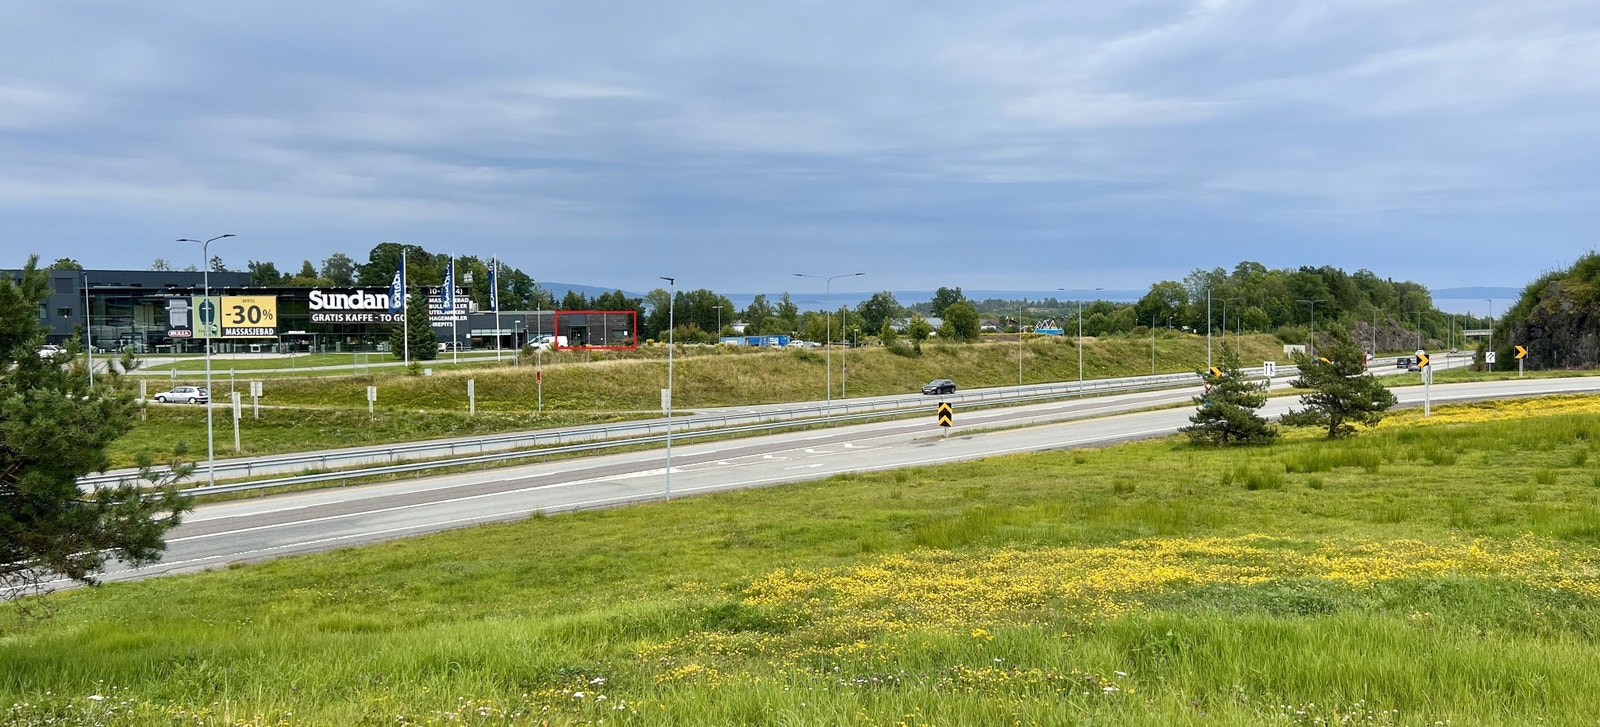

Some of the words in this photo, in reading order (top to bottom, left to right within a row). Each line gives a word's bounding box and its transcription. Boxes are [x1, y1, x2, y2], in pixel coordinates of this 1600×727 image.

[309, 290, 411, 310] Sundan
[312, 313, 343, 322] GRATIS
[345, 313, 373, 322] KAFFE
[381, 313, 392, 322] TO
[225, 328, 274, 336] MASSASJEBAD
